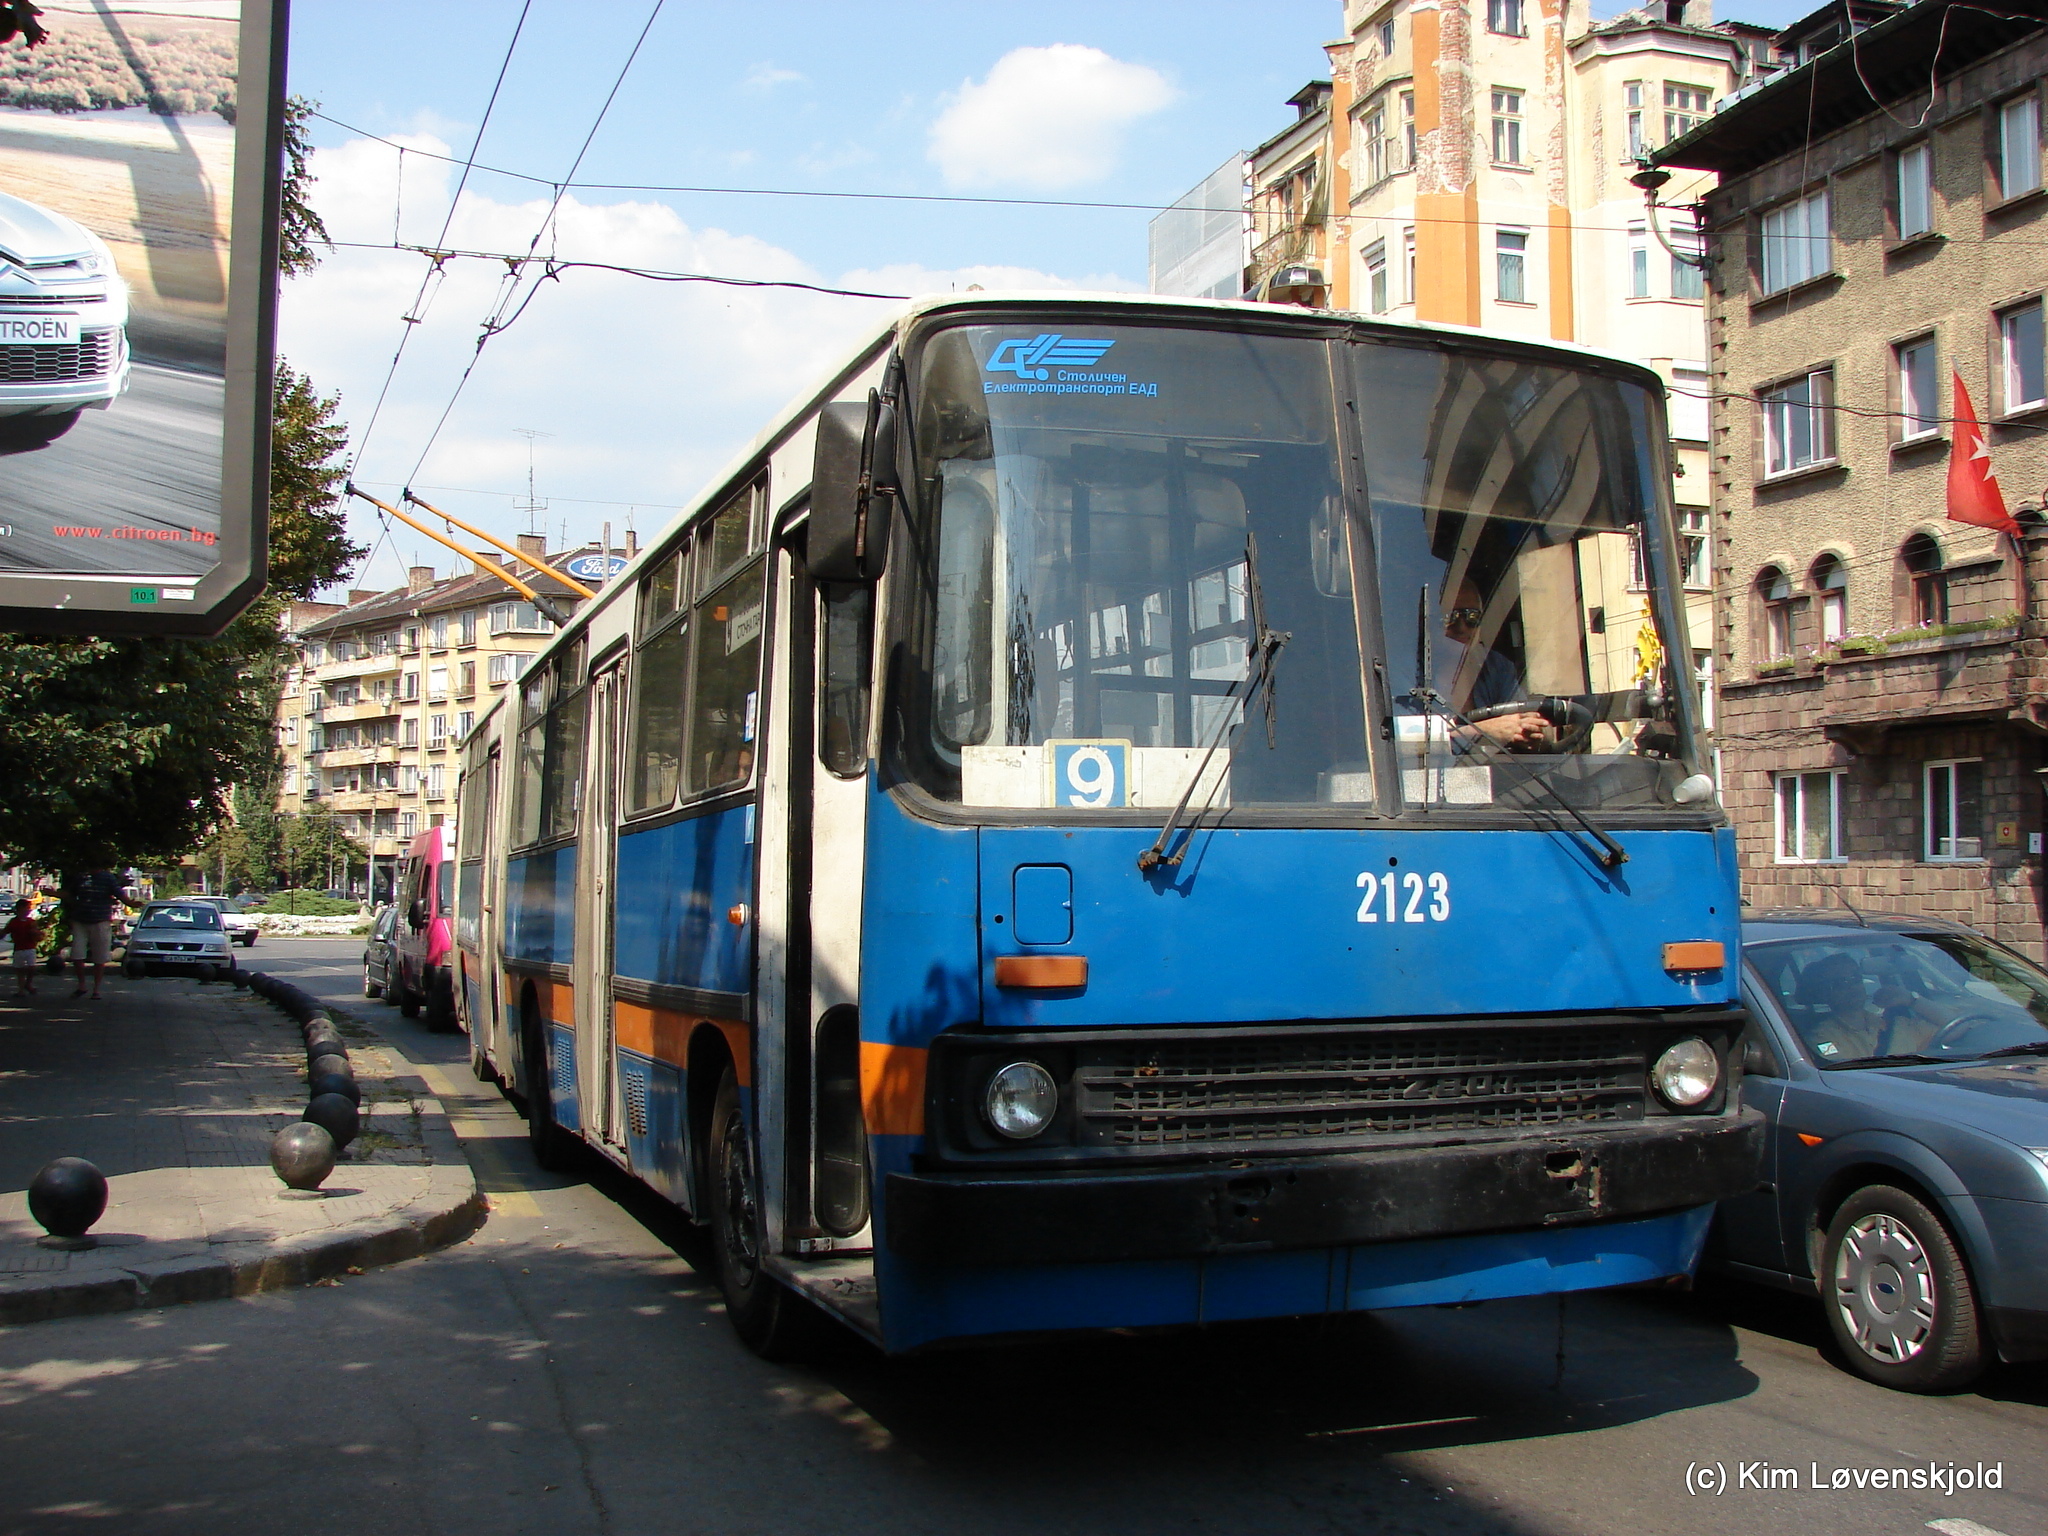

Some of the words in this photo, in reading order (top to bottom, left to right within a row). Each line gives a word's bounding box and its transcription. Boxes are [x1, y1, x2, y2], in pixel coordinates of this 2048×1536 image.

[1057, 370, 1127, 383] Столичен
[983, 382, 1125, 395] Електротранспорт
[1129, 382, 1158, 397] ЕАД
[53, 525, 216, 546] www.citroen.bg
[581, 559, 621, 575] Fod
[134, 591, 156, 601] 10.1
[1067, 746, 1115, 808] 9
[1356, 871, 1450, 922] 2123
